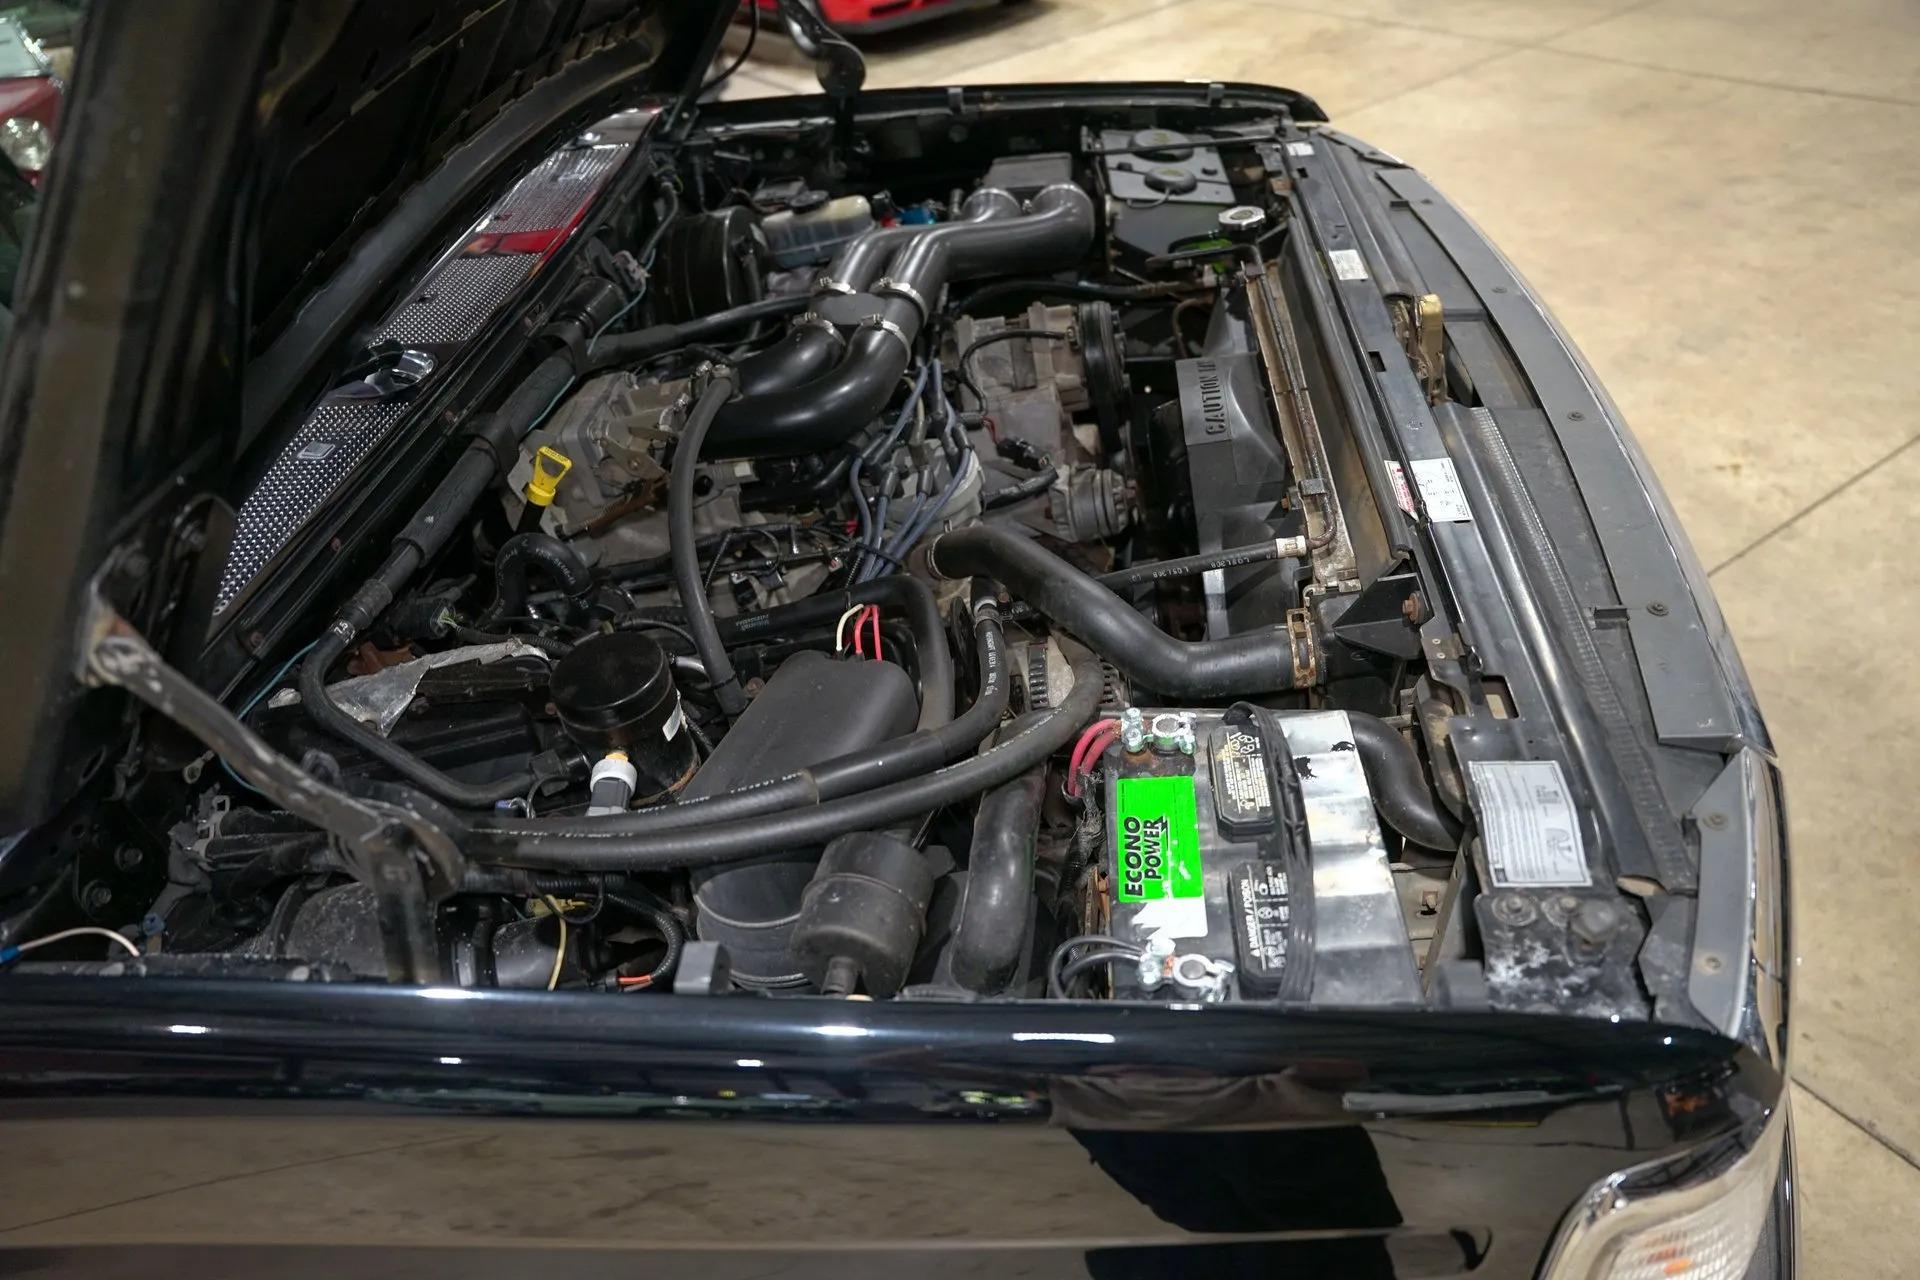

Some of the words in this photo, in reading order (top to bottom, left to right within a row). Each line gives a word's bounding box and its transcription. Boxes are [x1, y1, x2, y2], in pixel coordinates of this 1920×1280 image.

[1199, 375, 1226, 435] CAUTION
[1124, 816, 1143, 896] ECONO
[1143, 817, 1163, 880] POWER
